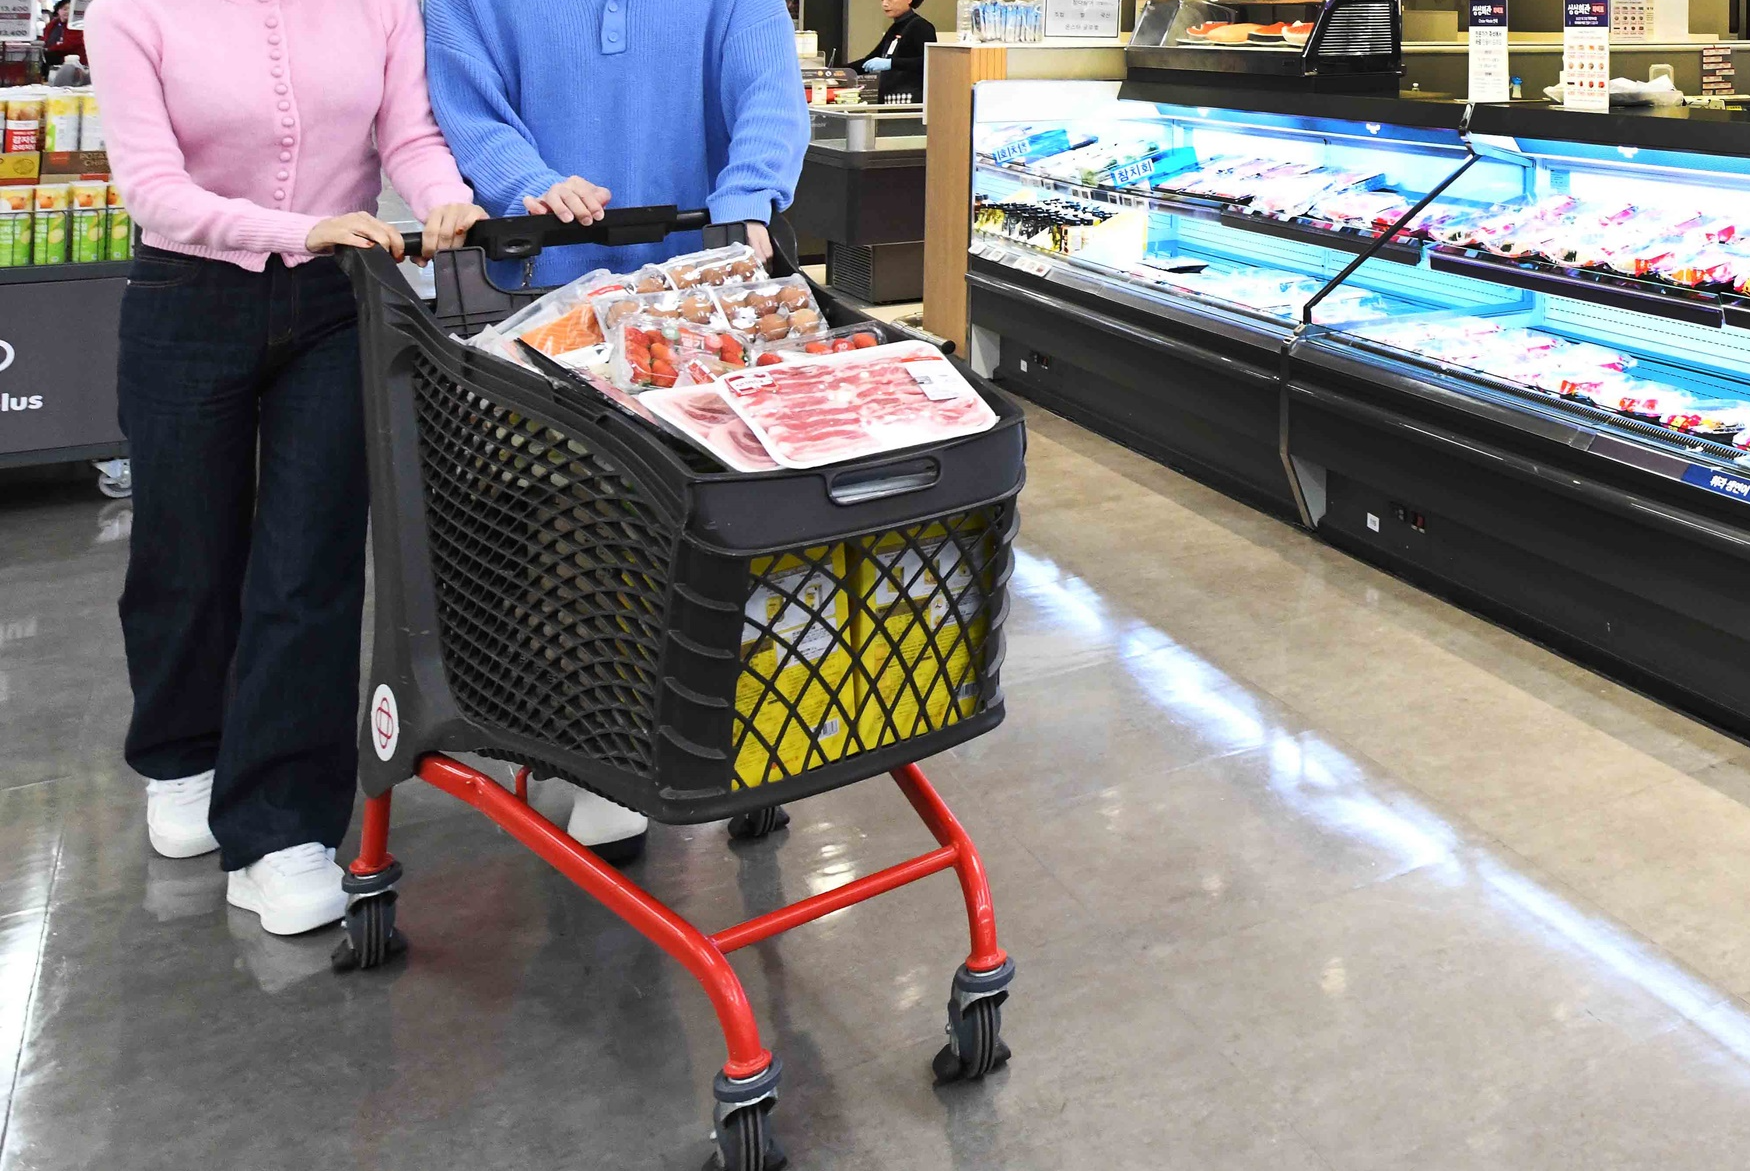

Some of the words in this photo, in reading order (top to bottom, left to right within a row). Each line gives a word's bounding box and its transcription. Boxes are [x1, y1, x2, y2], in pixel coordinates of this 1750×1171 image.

[1567, 3, 1591, 15] 싱싱회관
[1117, 160, 1153, 183] 참치회
[1724, 479, 1750, 497] 생연어
